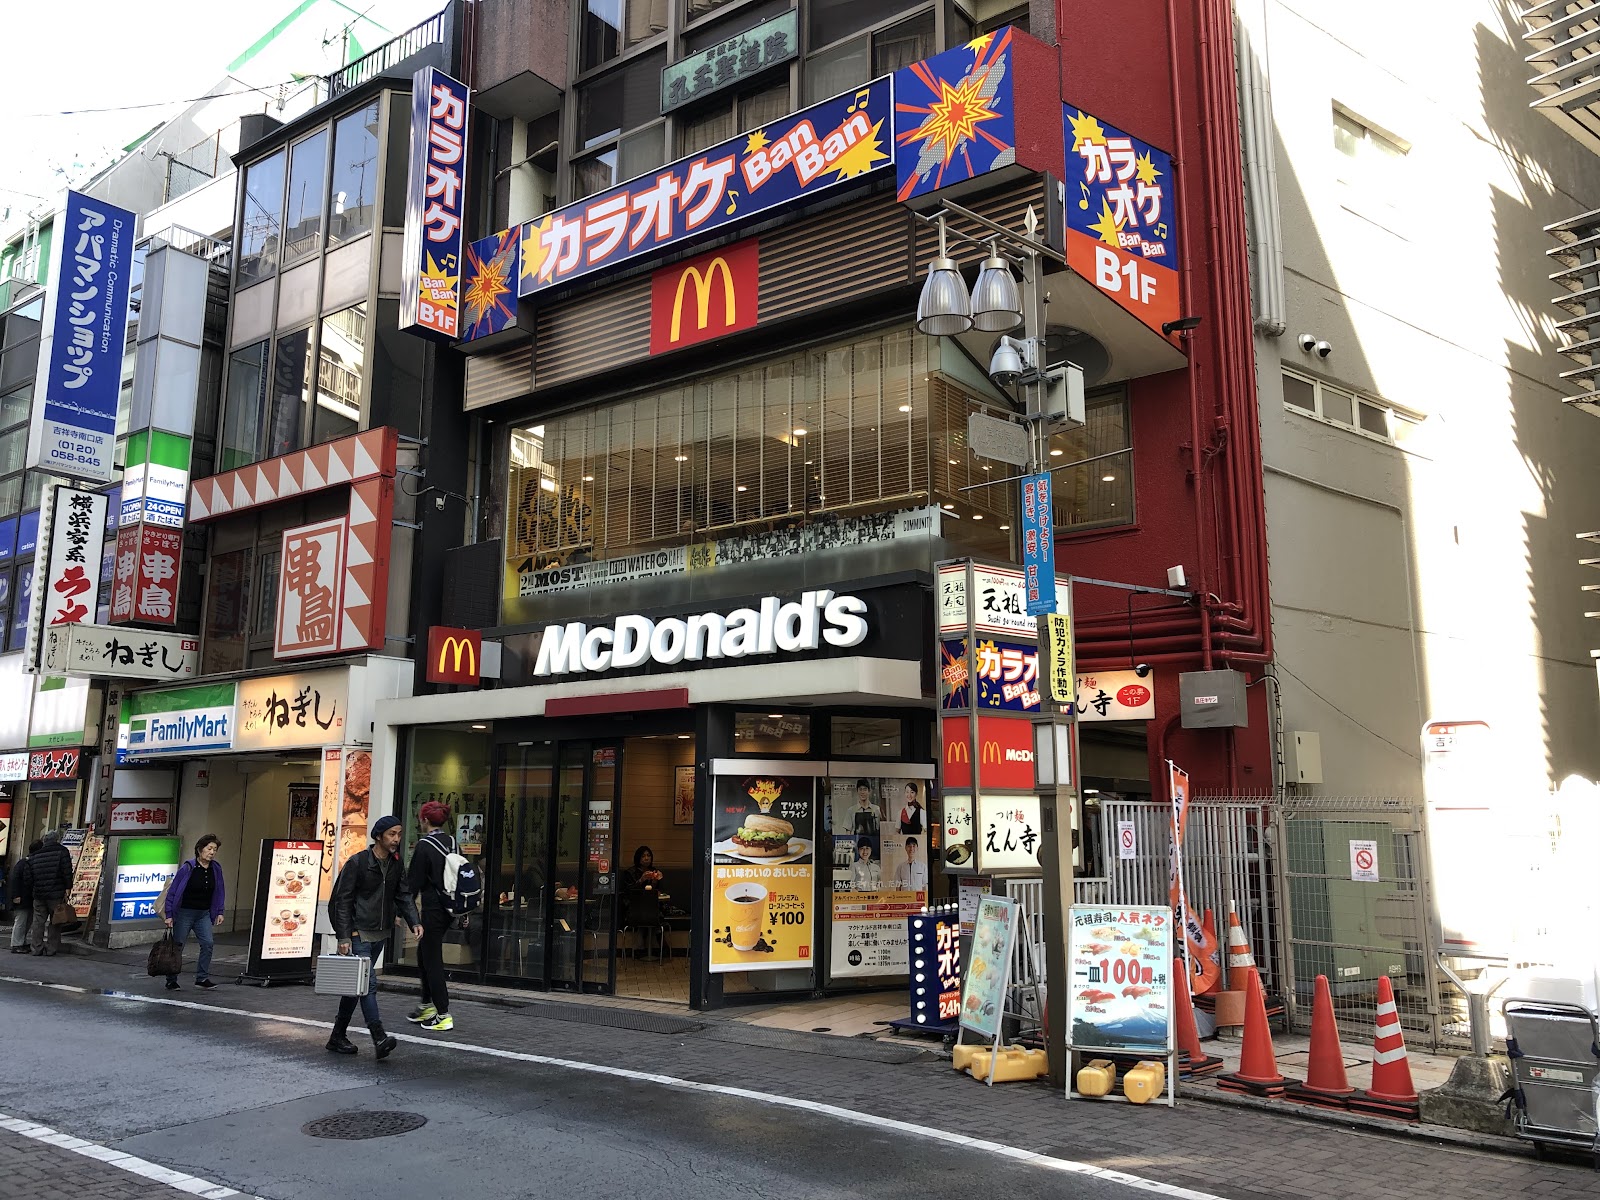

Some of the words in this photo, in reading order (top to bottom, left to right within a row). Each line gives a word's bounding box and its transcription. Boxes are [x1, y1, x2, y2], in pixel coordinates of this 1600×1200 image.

[424, 84, 464, 243] カラオケ
[1078, 138, 1137, 183] カラ
[538, 155, 736, 284] カラオケ
[742, 120, 816, 192] Ban
[795, 112, 872, 186] Ban
[1106, 182, 1163, 227] オケ
[109, 219, 123, 269] Dramatic
[1119, 231, 1141, 247] Ban
[1142, 242, 1165, 256] Ban
[1095, 246, 1157, 304] B1F
[422, 277, 446, 290] Ban
[63, 207, 106, 389] アパマンショップ
[431, 288, 454, 301] Ban
[101, 271, 118, 353] Communication
[419, 301, 455, 330] B1F
[53, 426, 104, 445] 吉祥寺南口店
[58, 440, 96, 455] (0120)
[51, 449, 101, 467] 058-845
[150, 476, 184, 490] FamilyMart
[146, 512, 155, 522] 酒
[157, 513, 181, 526] たばこ
[903, 516, 933, 532] COMMUNITY
[65, 494, 94, 563] 横浜家系
[627, 553, 655, 573] WATER
[113, 550, 135, 616] 串鳥
[138, 550, 175, 618] 串鳥
[535, 566, 583, 588] MOST
[286, 537, 332, 643] 串鳥
[944, 582, 965, 594] 元祖
[987, 614, 1001, 624] Sushi
[532, 588, 868, 677] McDonald's
[102, 636, 184, 672] ねぎし
[183, 641, 196, 651] B1
[1055, 617, 1068, 699] 防犯カメラ作動中
[944, 664, 962, 678] Ban
[950, 670, 968, 684] Ban
[1002, 682, 1027, 702] Ban
[1122, 688, 1145, 696] この奥
[1126, 697, 1141, 705] 1F
[263, 684, 337, 735] ねぎし
[150, 714, 227, 743] FamilyMart
[42, 752, 78, 778] ラーメン
[781, 801, 808, 811] てりやき
[136, 808, 168, 824] 串鳥
[781, 810, 808, 819] マフィン
[947, 813, 972, 825] えん寺
[996, 809, 1025, 823] つけ麺
[986, 824, 1037, 855] えん寺
[288, 855, 316, 866] ねぎし
[118, 871, 174, 885] FamilyMart
[769, 891, 777, 903] 新
[777, 894, 799, 902] プレミアム
[121, 902, 135, 918] 酒
[769, 902, 805, 910] ローストコーヒーS
[769, 911, 805, 926] ¥100
[1075, 911, 1165, 927] 元祖寿司の人気ネタ
